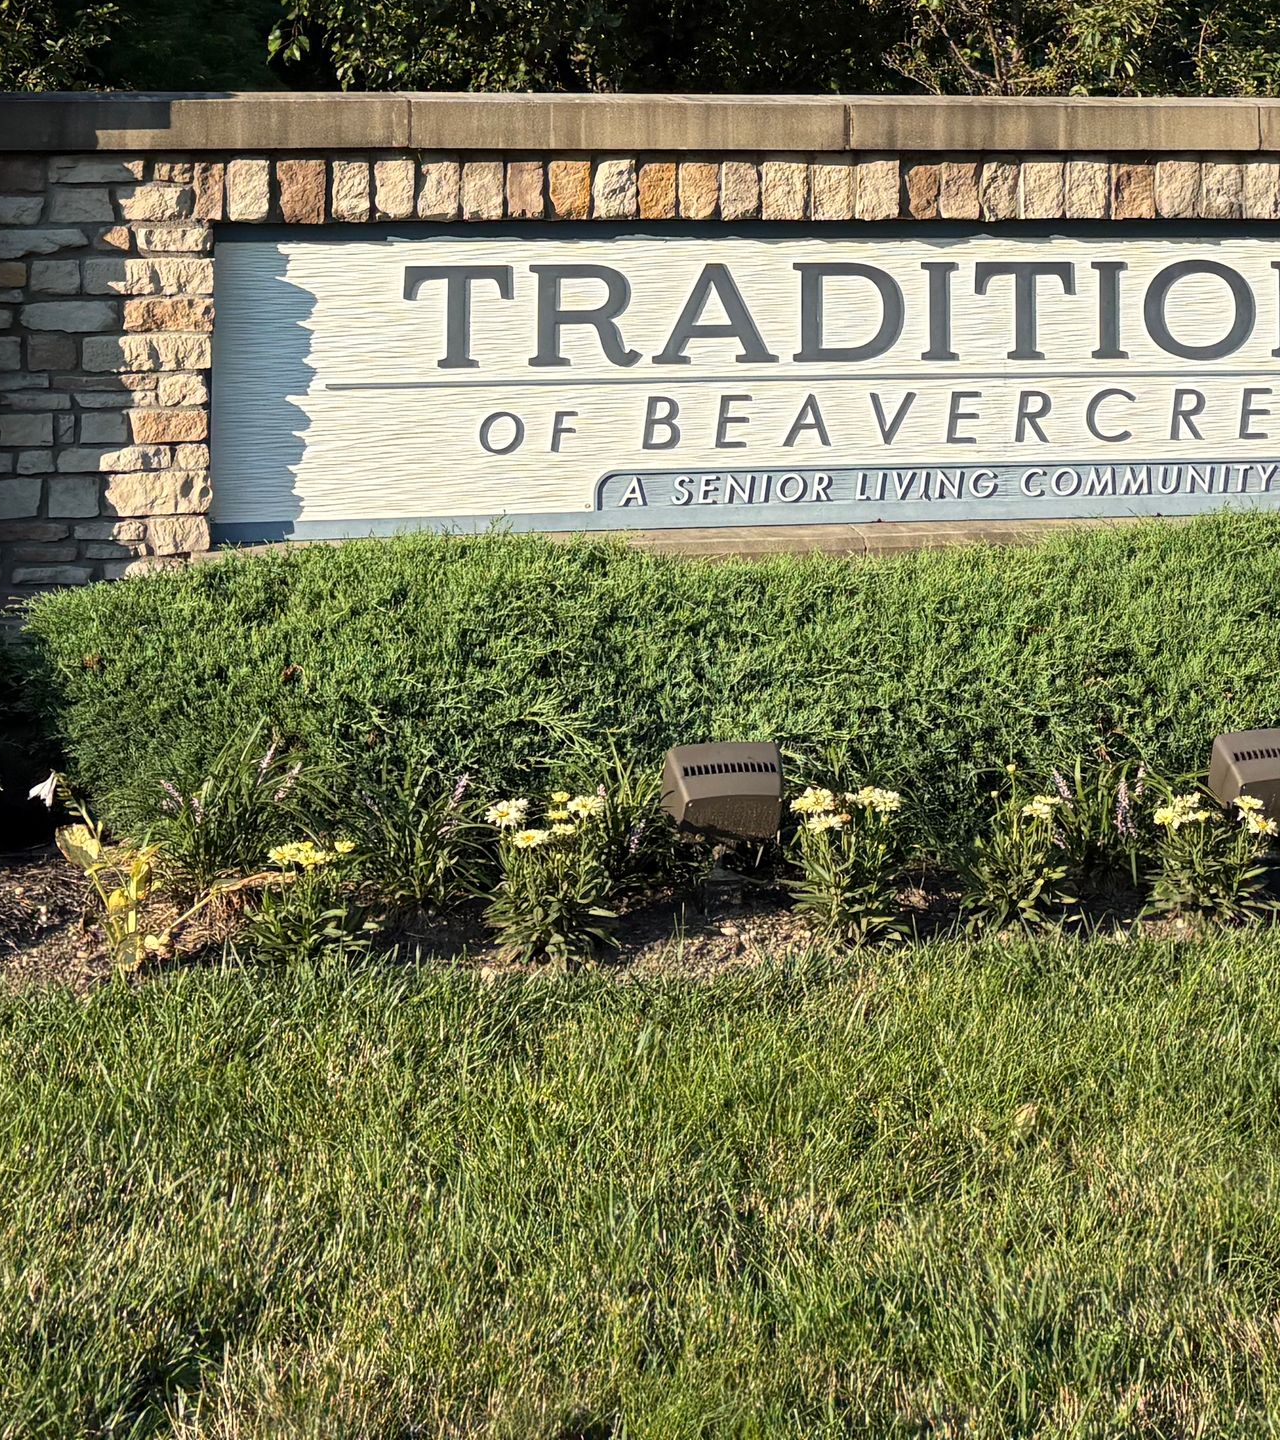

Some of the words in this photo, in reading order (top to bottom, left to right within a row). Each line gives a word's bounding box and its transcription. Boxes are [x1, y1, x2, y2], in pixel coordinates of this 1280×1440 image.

[478, 410, 579, 455] OF
[617, 474, 648, 507] A
[670, 472, 834, 505] SENIOR
[855, 468, 998, 500] LIVING
[1020, 463, 1279, 498] COMMUNITY
